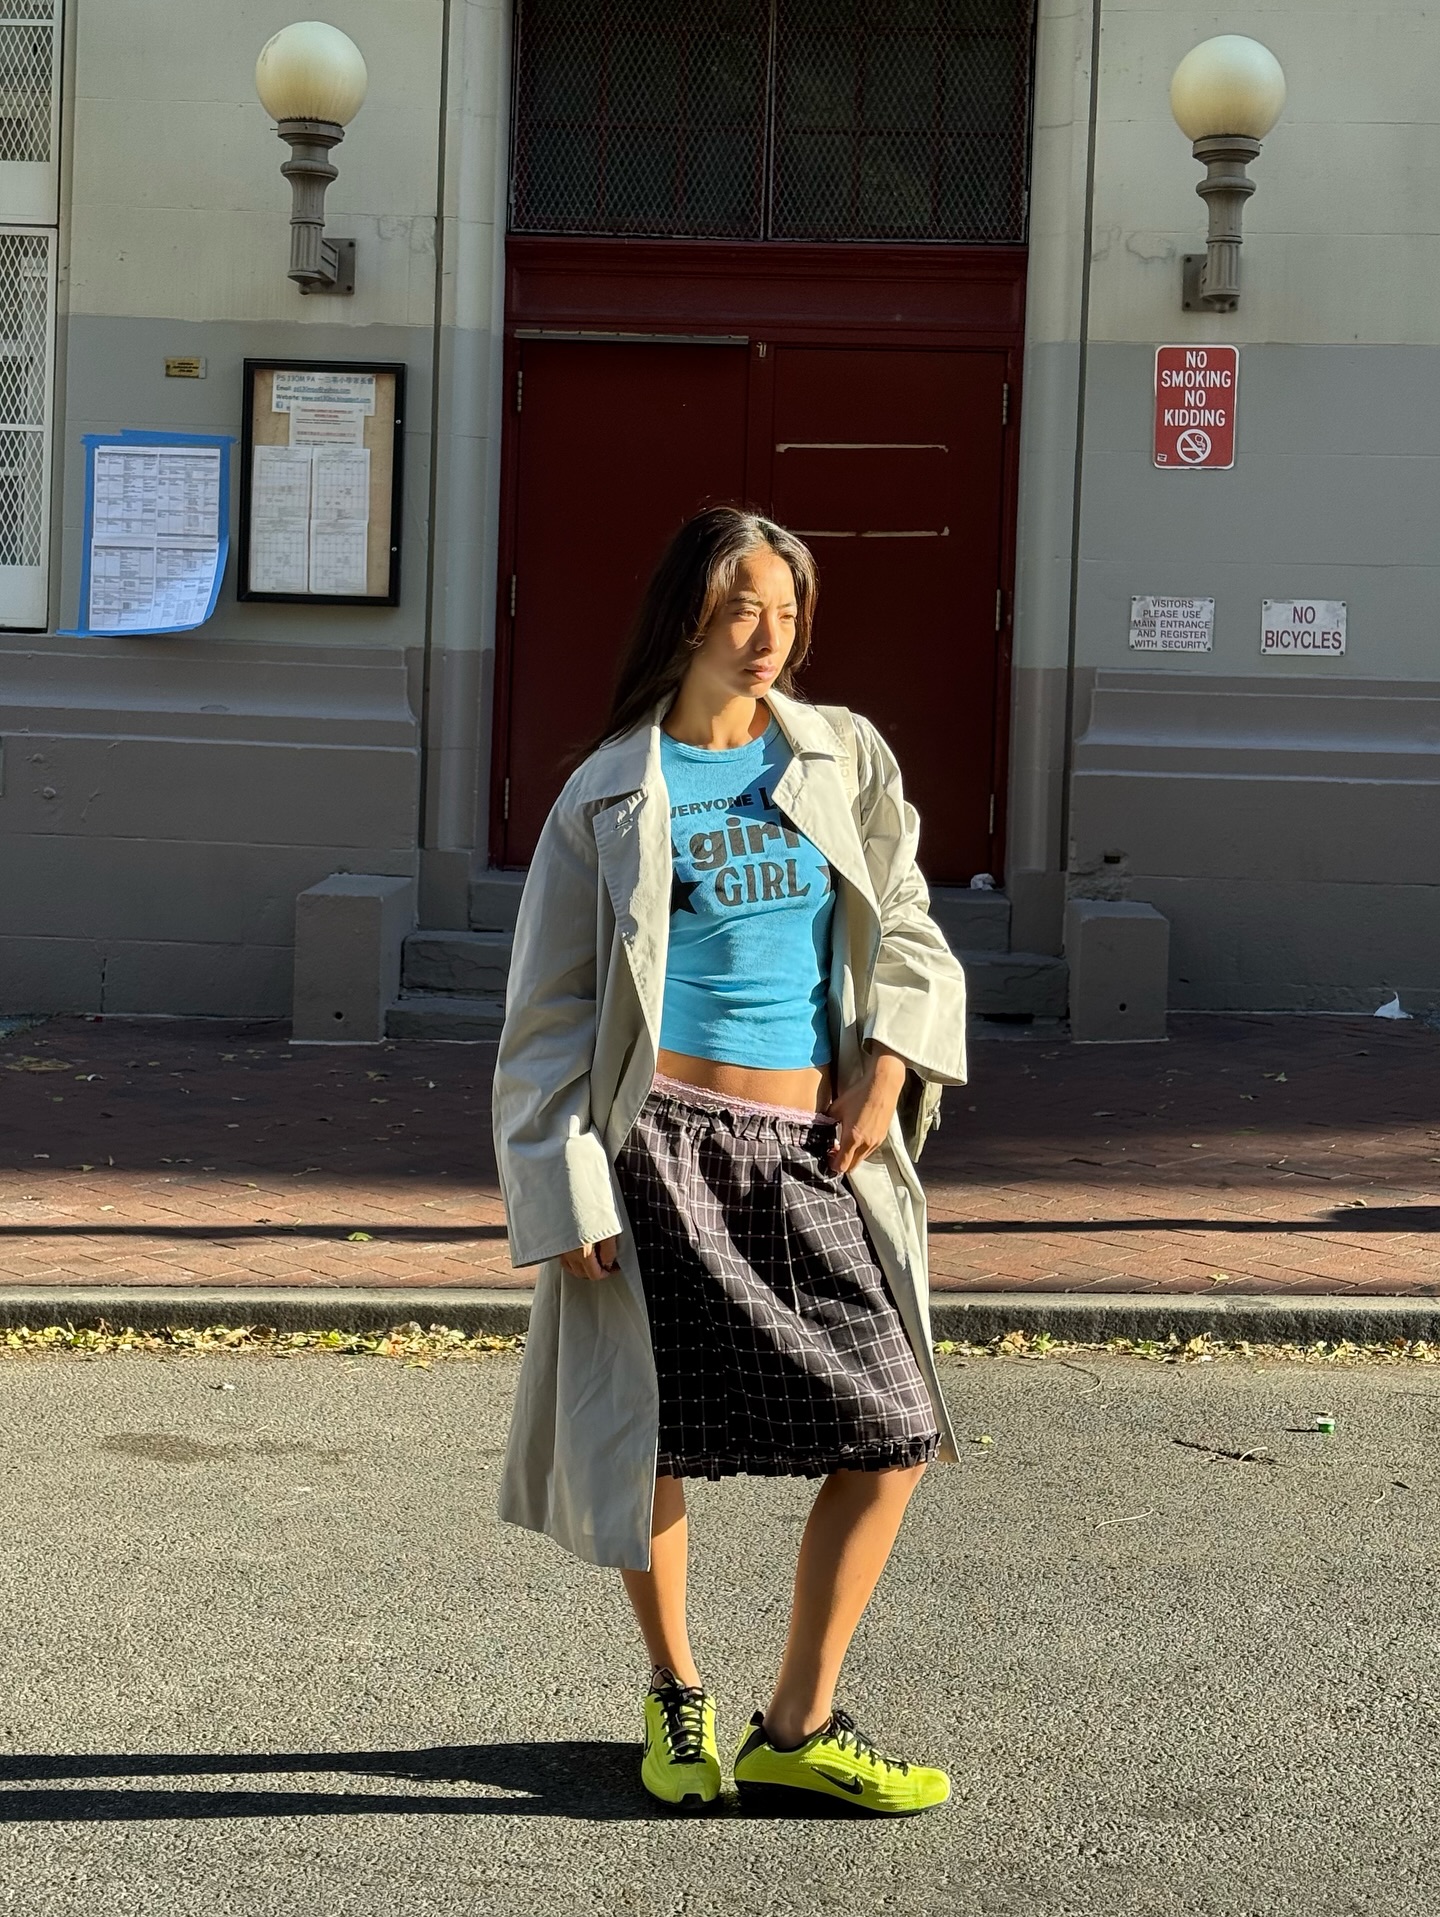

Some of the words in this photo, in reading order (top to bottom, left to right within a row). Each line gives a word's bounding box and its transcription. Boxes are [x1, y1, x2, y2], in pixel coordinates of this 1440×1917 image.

[1185, 350, 1208, 369] NO
[1161, 370, 1232, 388] SMOKING
[1184, 389, 1207, 407] NO
[1164, 409, 1226, 427] KIDDING
[1151, 599, 1194, 608] VISITORS
[1143, 609, 1179, 619] PLEASE
[1182, 610, 1202, 619] USE
[1292, 605, 1316, 624] NO
[1133, 619, 1156, 628] MAIN
[1160, 620, 1211, 629] ENTRANCE
[1137, 629, 1157, 638] AND
[1160, 630, 1207, 639] REGISTER
[1264, 629, 1342, 650] BICYCLES
[1134, 639, 1158, 648] WITH
[1161, 640, 1208, 649] SECURITY
[670, 793, 754, 819] VERYONE
[689, 812, 801, 871] girl
[714, 858, 811, 907] GIRL
